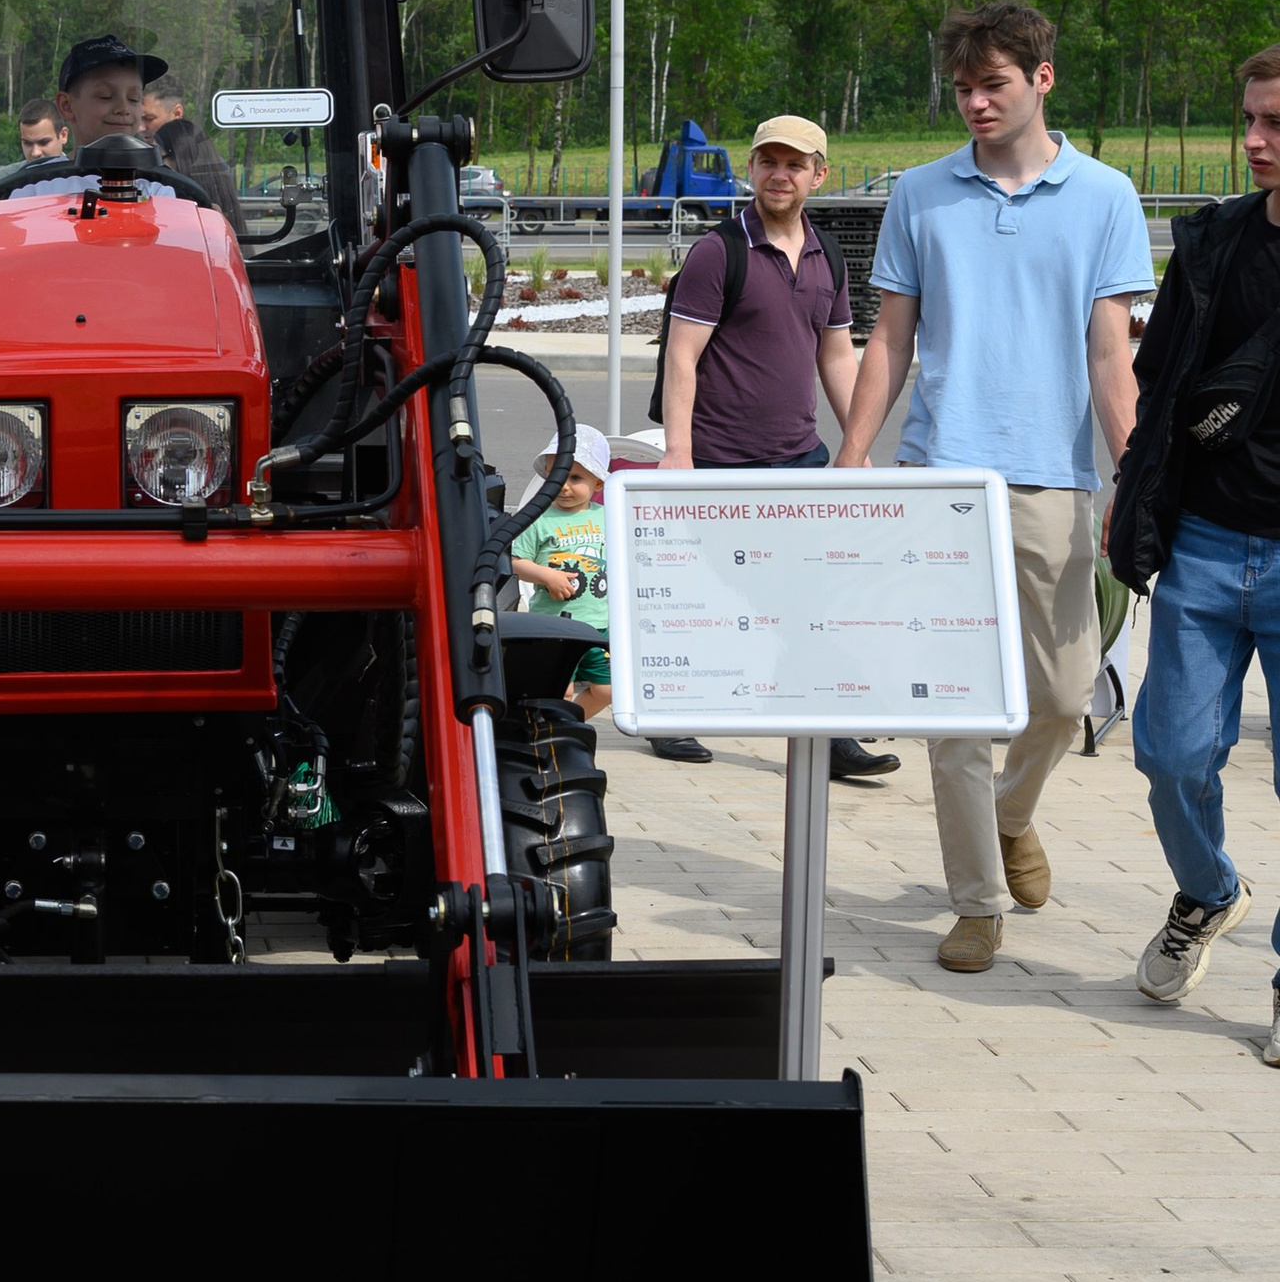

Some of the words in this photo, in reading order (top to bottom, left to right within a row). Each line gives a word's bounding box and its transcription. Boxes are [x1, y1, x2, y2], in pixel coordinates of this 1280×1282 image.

[633, 505, 751, 520] ТЕХНИЧЕСКИЕ
[756, 504, 904, 518] ХАРАКТЕРИСТИКИ
[634, 527, 665, 537] ОТ-18
[658, 537, 702, 546] ТРАКТОРНЫЙ
[656, 553, 677, 561] 2000
[826, 551, 845, 559] 1800
[925, 551, 944, 560] 1800
[953, 551, 969, 559] 590
[637, 587, 672, 599] ЩТ-15
[664, 602, 705, 610] ТРАКТОРНАЯ
[930, 618, 947, 626] 1710
[641, 670, 689, 678] ПОГРУЗОЧНОЕ
[692, 669, 745, 677] ОБОРУДОВАНИЕ
[660, 683, 675, 692] 320
[837, 683, 856, 691] 1700
[935, 684, 955, 692] 2700
